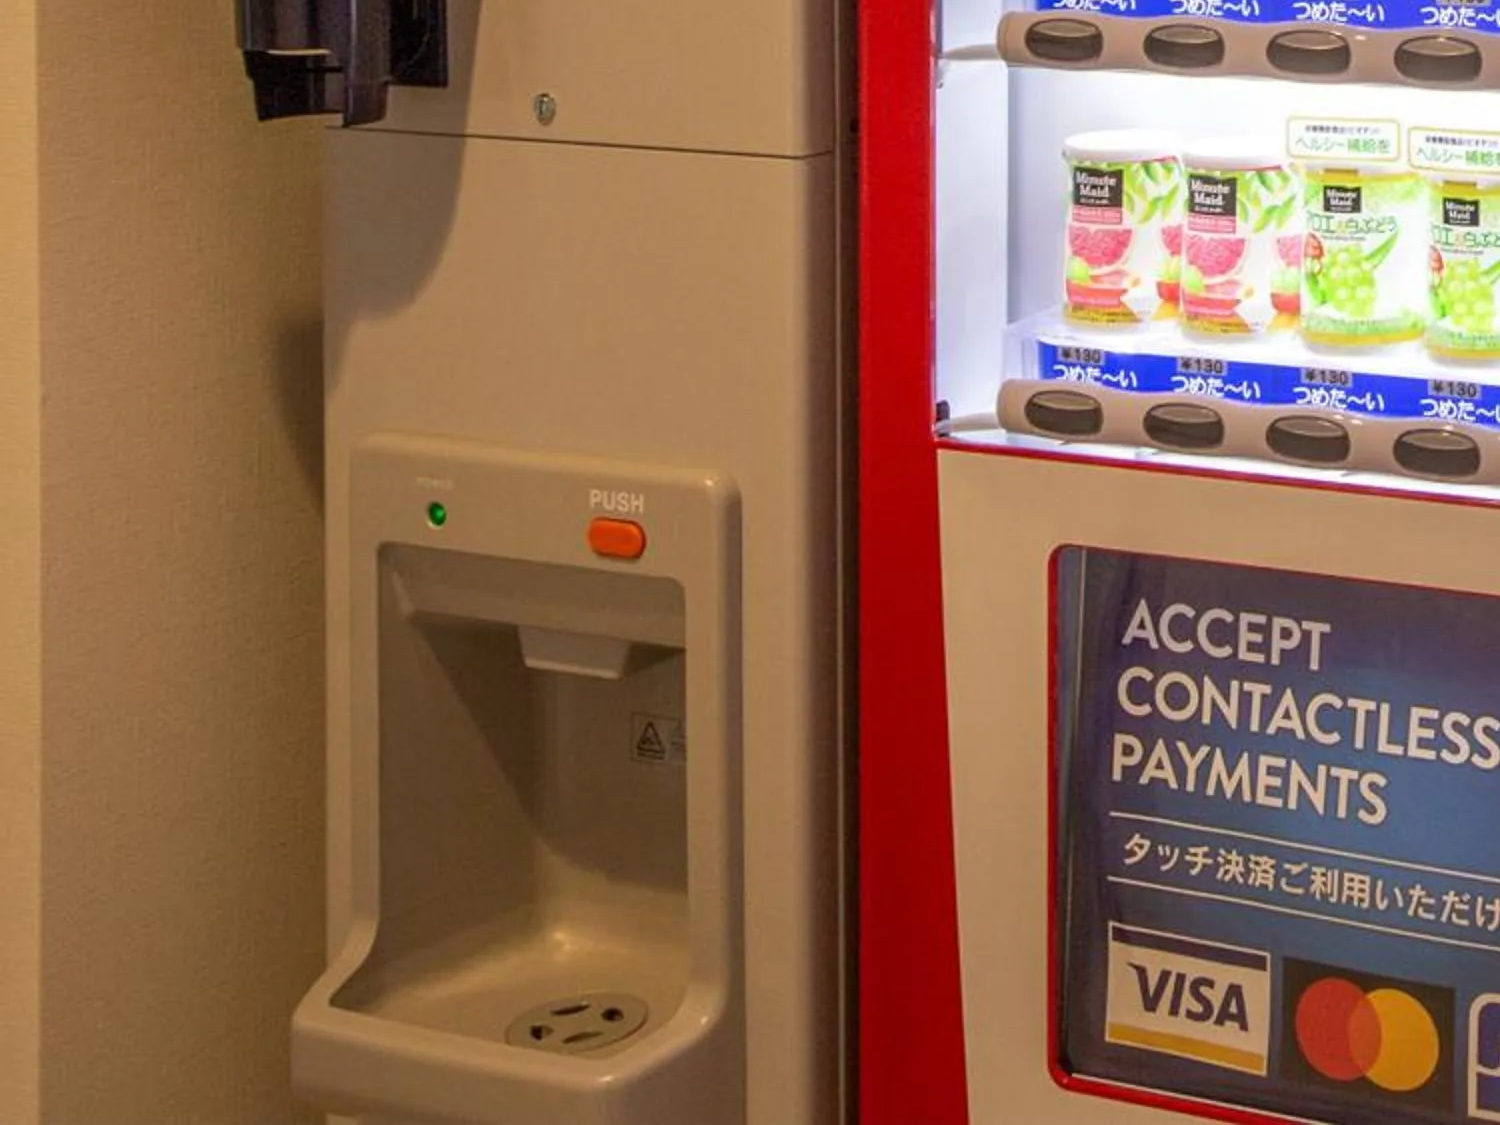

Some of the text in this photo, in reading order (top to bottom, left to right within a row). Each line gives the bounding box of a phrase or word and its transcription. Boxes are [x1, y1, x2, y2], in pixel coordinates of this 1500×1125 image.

[1079, 183, 1110, 198] Maid
[1192, 190, 1225, 207] Maid
[1060, 349, 1101, 364] ¥130
[1180, 358, 1224, 374] ¥130
[1305, 369, 1349, 386] ¥130
[1431, 381, 1478, 398] ¥130
[588, 488, 645, 516] PUSH
[1121, 597, 1332, 672] ACCEPT
[1111, 732, 1390, 826] PAYMENTS
[1126, 961, 1250, 1033] VISA
